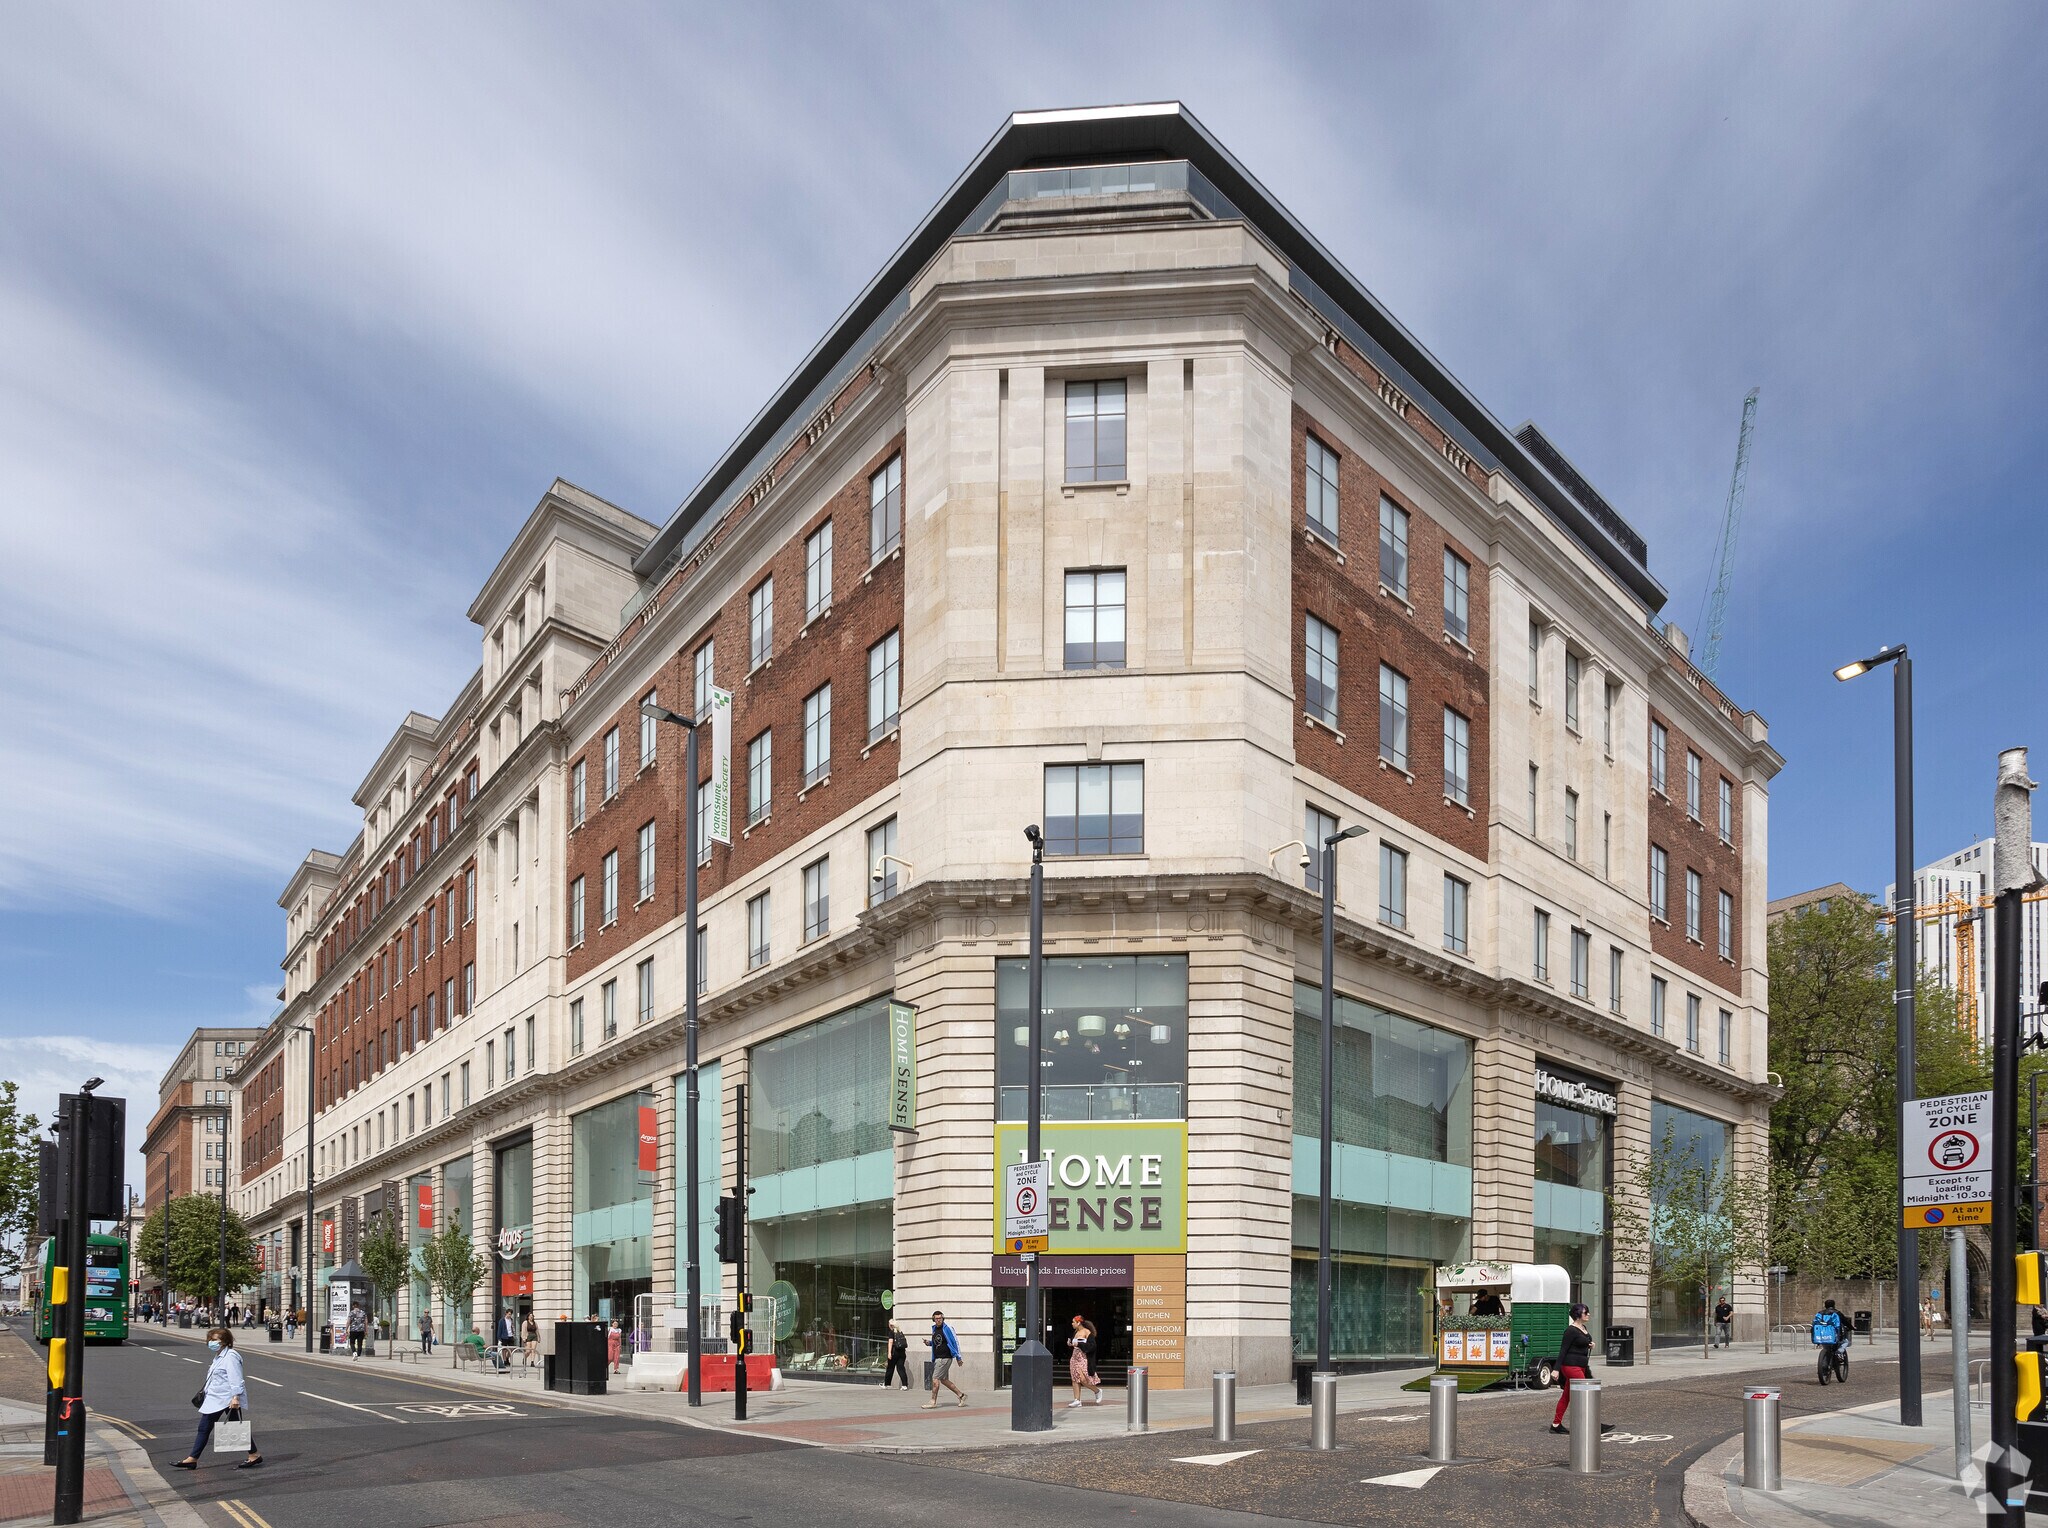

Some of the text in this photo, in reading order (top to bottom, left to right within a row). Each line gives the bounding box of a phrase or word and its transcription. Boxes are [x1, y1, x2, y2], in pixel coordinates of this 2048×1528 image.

[713, 782, 721, 834] YORKSHIRE
[1920, 1094, 1988, 1109] PEDESTRIAN
[1925, 1103, 1981, 1116] and CYCLE
[1929, 1113, 1977, 1128] ZONE
[640, 1133, 657, 1141] Argos
[1013, 1163, 1041, 1172] PEDESTRIAN
[1017, 1176, 1037, 1186] ZONE
[1928, 1175, 1980, 1186] Except for
[1936, 1184, 1972, 1193] loading
[1907, 1193, 1949, 1203] Midnight
[1956, 1190, 1986, 1200] 10.30
[1049, 1197, 1162, 1229] ENSE
[1951, 1205, 1985, 1214] At any
[1957, 1212, 1979, 1221] time
[498, 1227, 523, 1251] Argos
[999, 1266, 1028, 1276] Unique
[1054, 1266, 1098, 1275] Irresistible
[1100, 1267, 1127, 1276] prices
[1479, 1268, 1499, 1282] Spice
[1136, 1298, 1164, 1306] DINING
[1136, 1325, 1182, 1333] BATHROOM
[1136, 1352, 1182, 1360] FURNITURE
